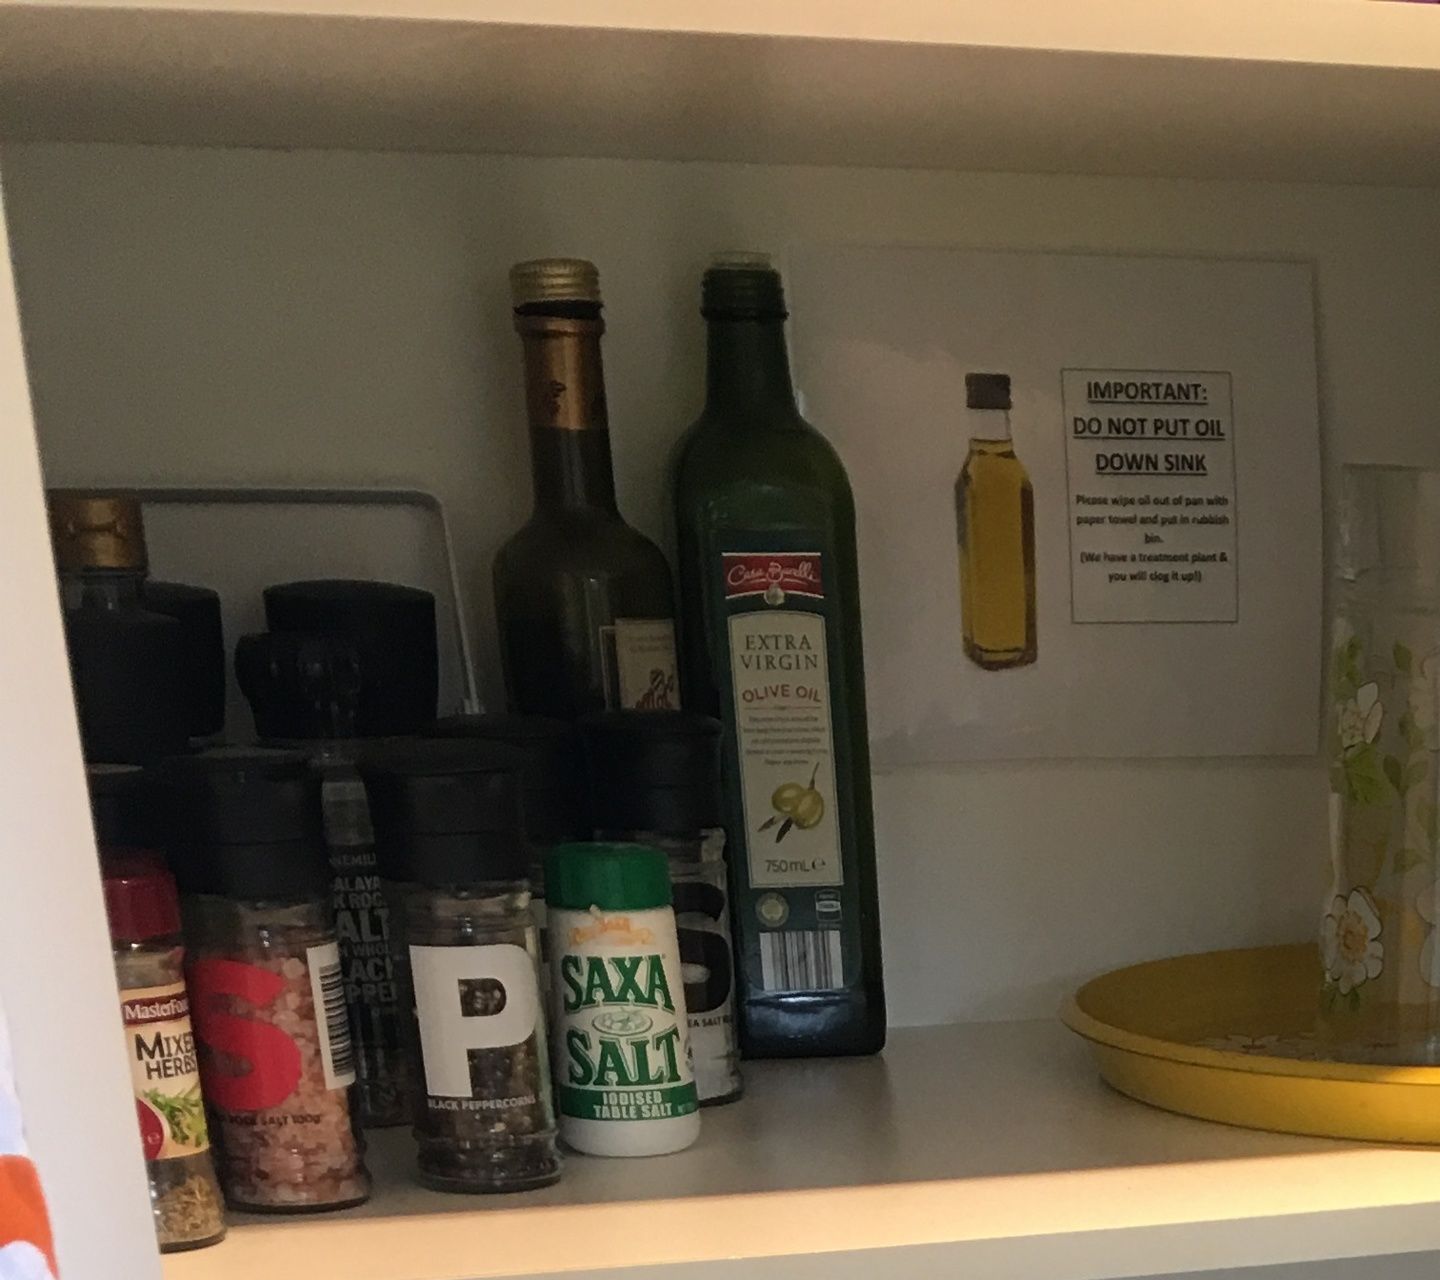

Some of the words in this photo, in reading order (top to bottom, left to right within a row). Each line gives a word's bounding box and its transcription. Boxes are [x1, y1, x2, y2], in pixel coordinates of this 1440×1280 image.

[1087, 380, 1207, 401] IMPORTANT:
[1073, 417, 1100, 436] DO
[1108, 418, 1147, 437] NOT
[1154, 419, 1190, 437] PUT
[1195, 419, 1225, 437] OIL
[1096, 454, 1158, 472] DOWN
[1164, 454, 1207, 472] SINK
[1076, 495, 1108, 506] Please
[1111, 495, 1135, 508] wipe
[1137, 494, 1151, 506] oil
[1152, 496, 1170, 506] out
[1172, 495, 1183, 506] of
[1185, 497, 1204, 508] pan
[1206, 495, 1229, 506] with
[1076, 514, 1105, 527] paper
[1108, 514, 1138, 525] towel
[1140, 514, 1159, 525] and
[1161, 515, 1178, 527] put
[1180, 514, 1190, 525] in
[1191, 514, 1230, 526] rubbish
[1144, 532, 1164, 544] bin.
[1080, 551, 1101, 564] (We
[1103, 552, 1128, 563] have
[1130, 554, 1137, 563] a
[1138, 553, 1189, 563] treatment
[1191, 552, 1217, 565] plant
[1219, 553, 1227, 563] &
[1108, 572, 1127, 583] you
[1129, 571, 1147, 582] will
[1149, 571, 1169, 584] clog
[1171, 571, 1180, 582] it
[745, 633, 812, 651] EXTRA
[740, 654, 819, 671] VIRGIN
[742, 684, 791, 703] OLIVE
[795, 685, 822, 703] OIL
[561, 954, 676, 1013] SAXA
[409, 943, 538, 1098] P
[566, 1026, 684, 1088] SALT
[427, 1097, 460, 1111] BLACK
[461, 1095, 537, 1111] PEPPERCORNS
[602, 1090, 663, 1107] IODISED
[592, 1104, 638, 1121] TABLE
[640, 1102, 673, 1120] SALT
